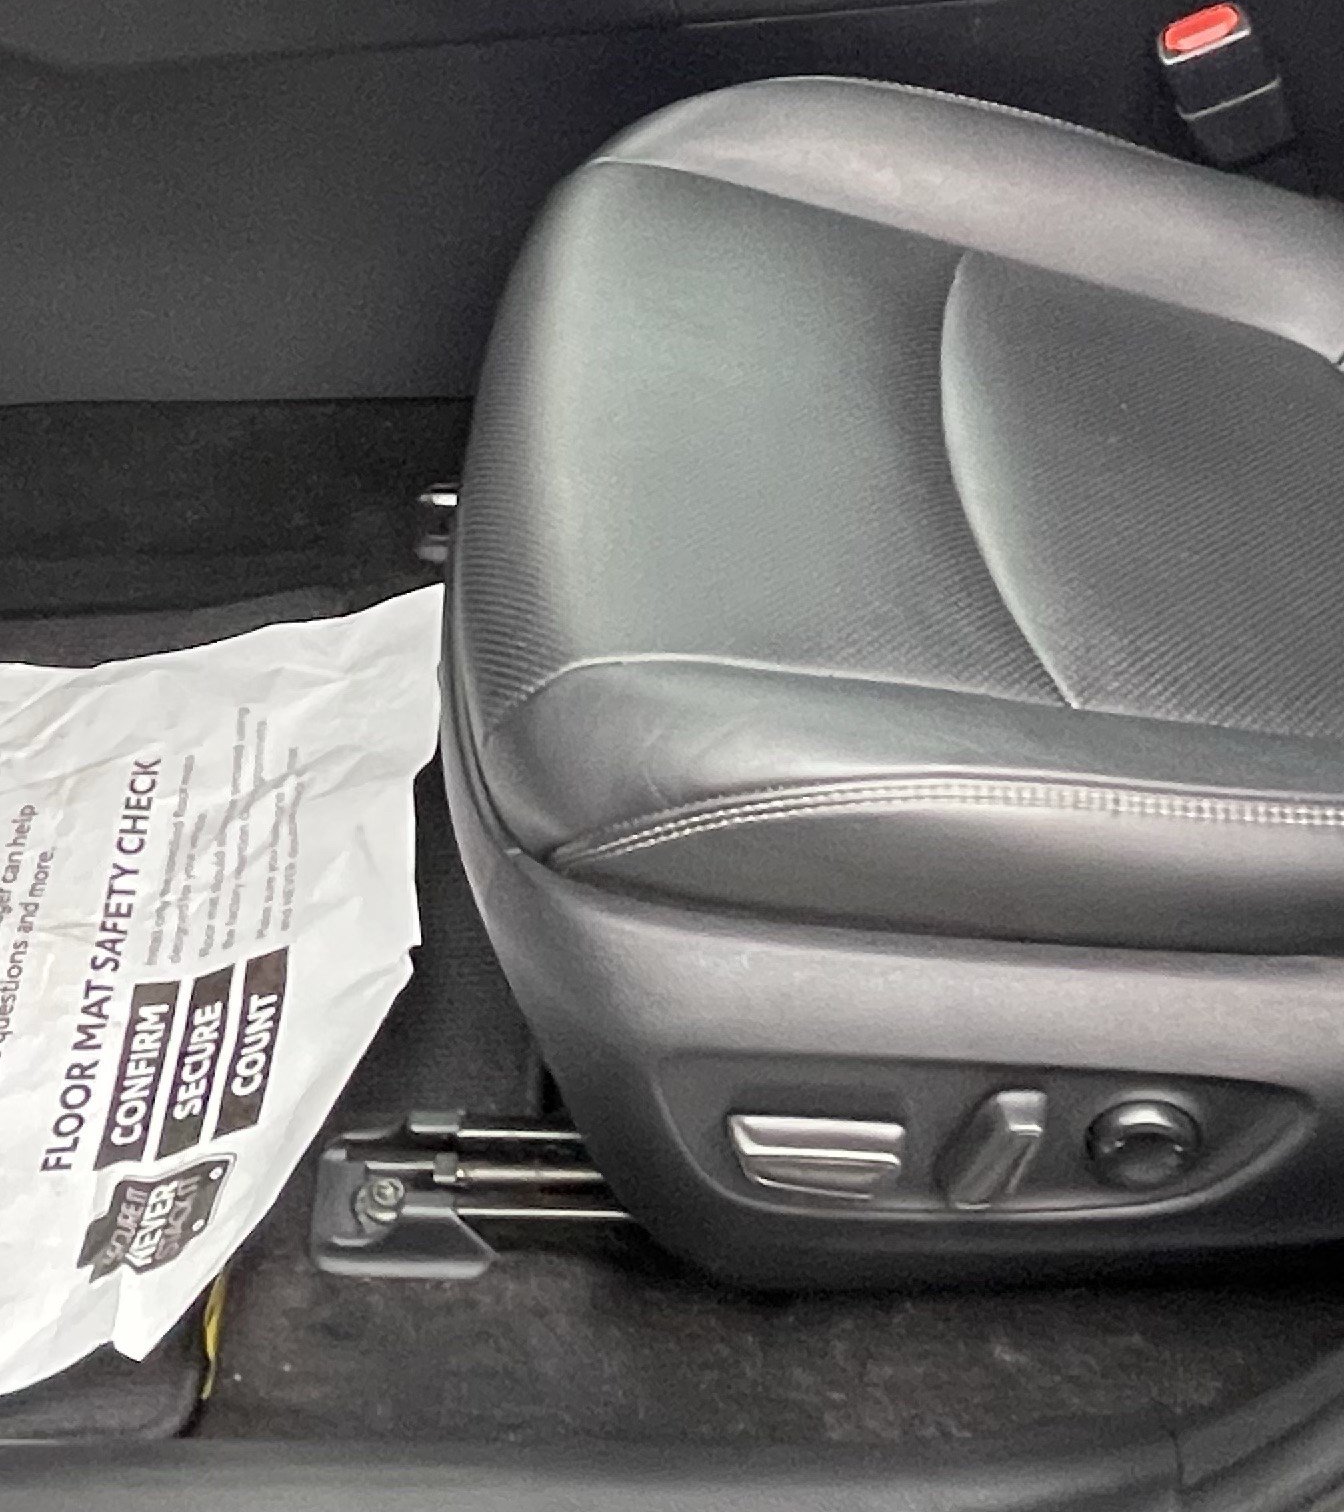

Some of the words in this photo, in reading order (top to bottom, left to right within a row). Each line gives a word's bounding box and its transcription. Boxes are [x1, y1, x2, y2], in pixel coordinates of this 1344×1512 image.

[9, 804, 38, 853] help
[116, 756, 163, 859] CHECK
[1, 853, 19, 885] can
[27, 847, 57, 900] more.
[17, 901, 41, 938] and
[93, 862, 141, 974] SAFETY
[72, 979, 112, 1059] MAT
[173, 1000, 224, 1121] SECURE
[232, 992, 278, 1097] COUNT
[41, 1062, 98, 1173] FLOOR
[110, 1002, 170, 1147] CONFIRM
[124, 1179, 179, 1268] NEVER
